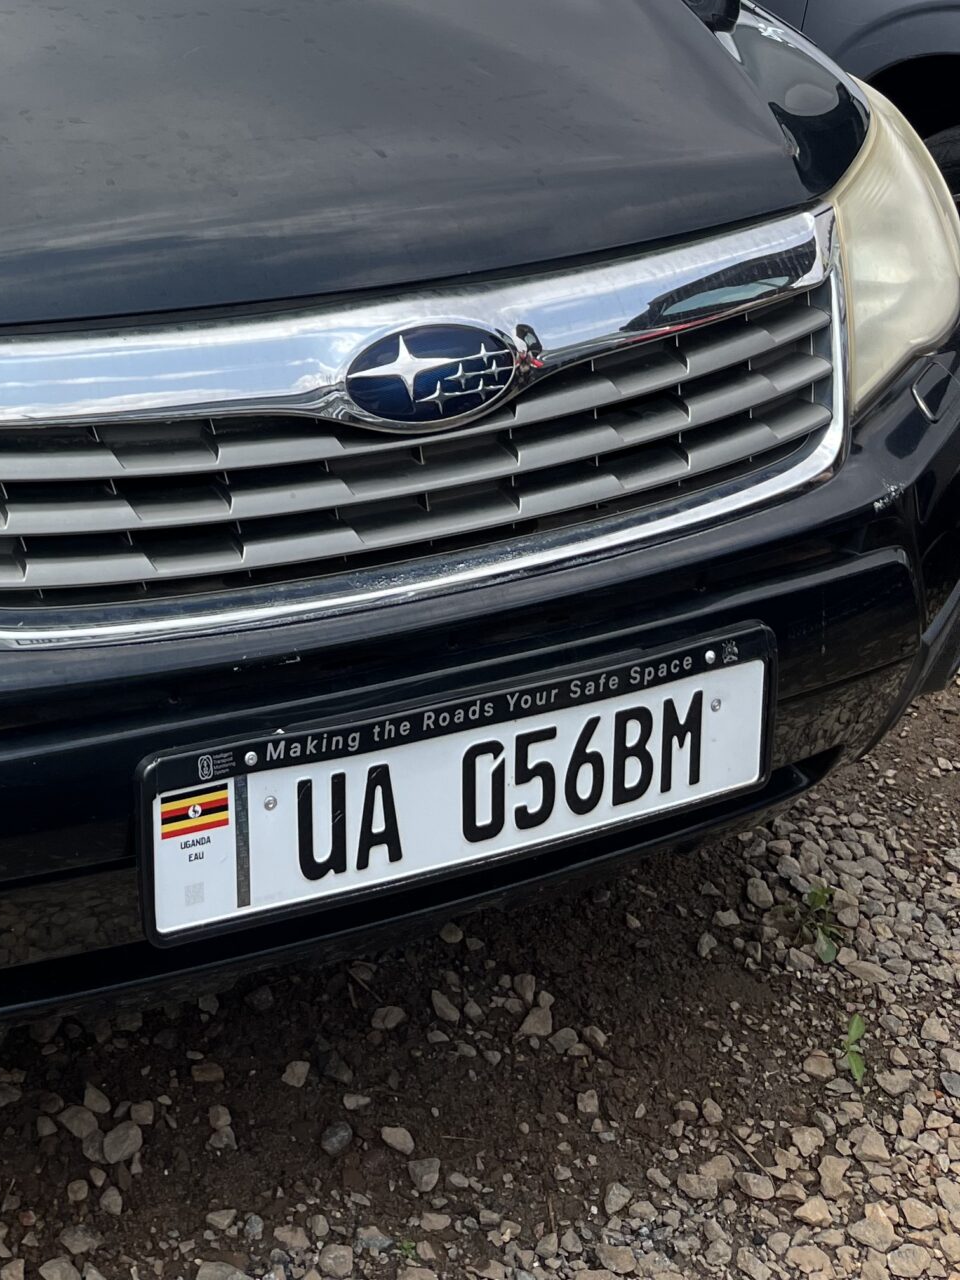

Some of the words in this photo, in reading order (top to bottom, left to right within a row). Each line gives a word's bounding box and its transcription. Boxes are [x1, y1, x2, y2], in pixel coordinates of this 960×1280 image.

[266, 731, 361, 762] Making
[373, 721, 411, 742] the
[423, 699, 494, 731] Roads
[506, 687, 559, 712] Your
[569, 674, 619, 698] Safe
[629, 656, 693, 685] Space
[297, 763, 403, 881] UA
[461, 690, 704, 843] 056BM
[180, 836, 212, 850] UGANDA
[188, 851, 205, 863] EAU
